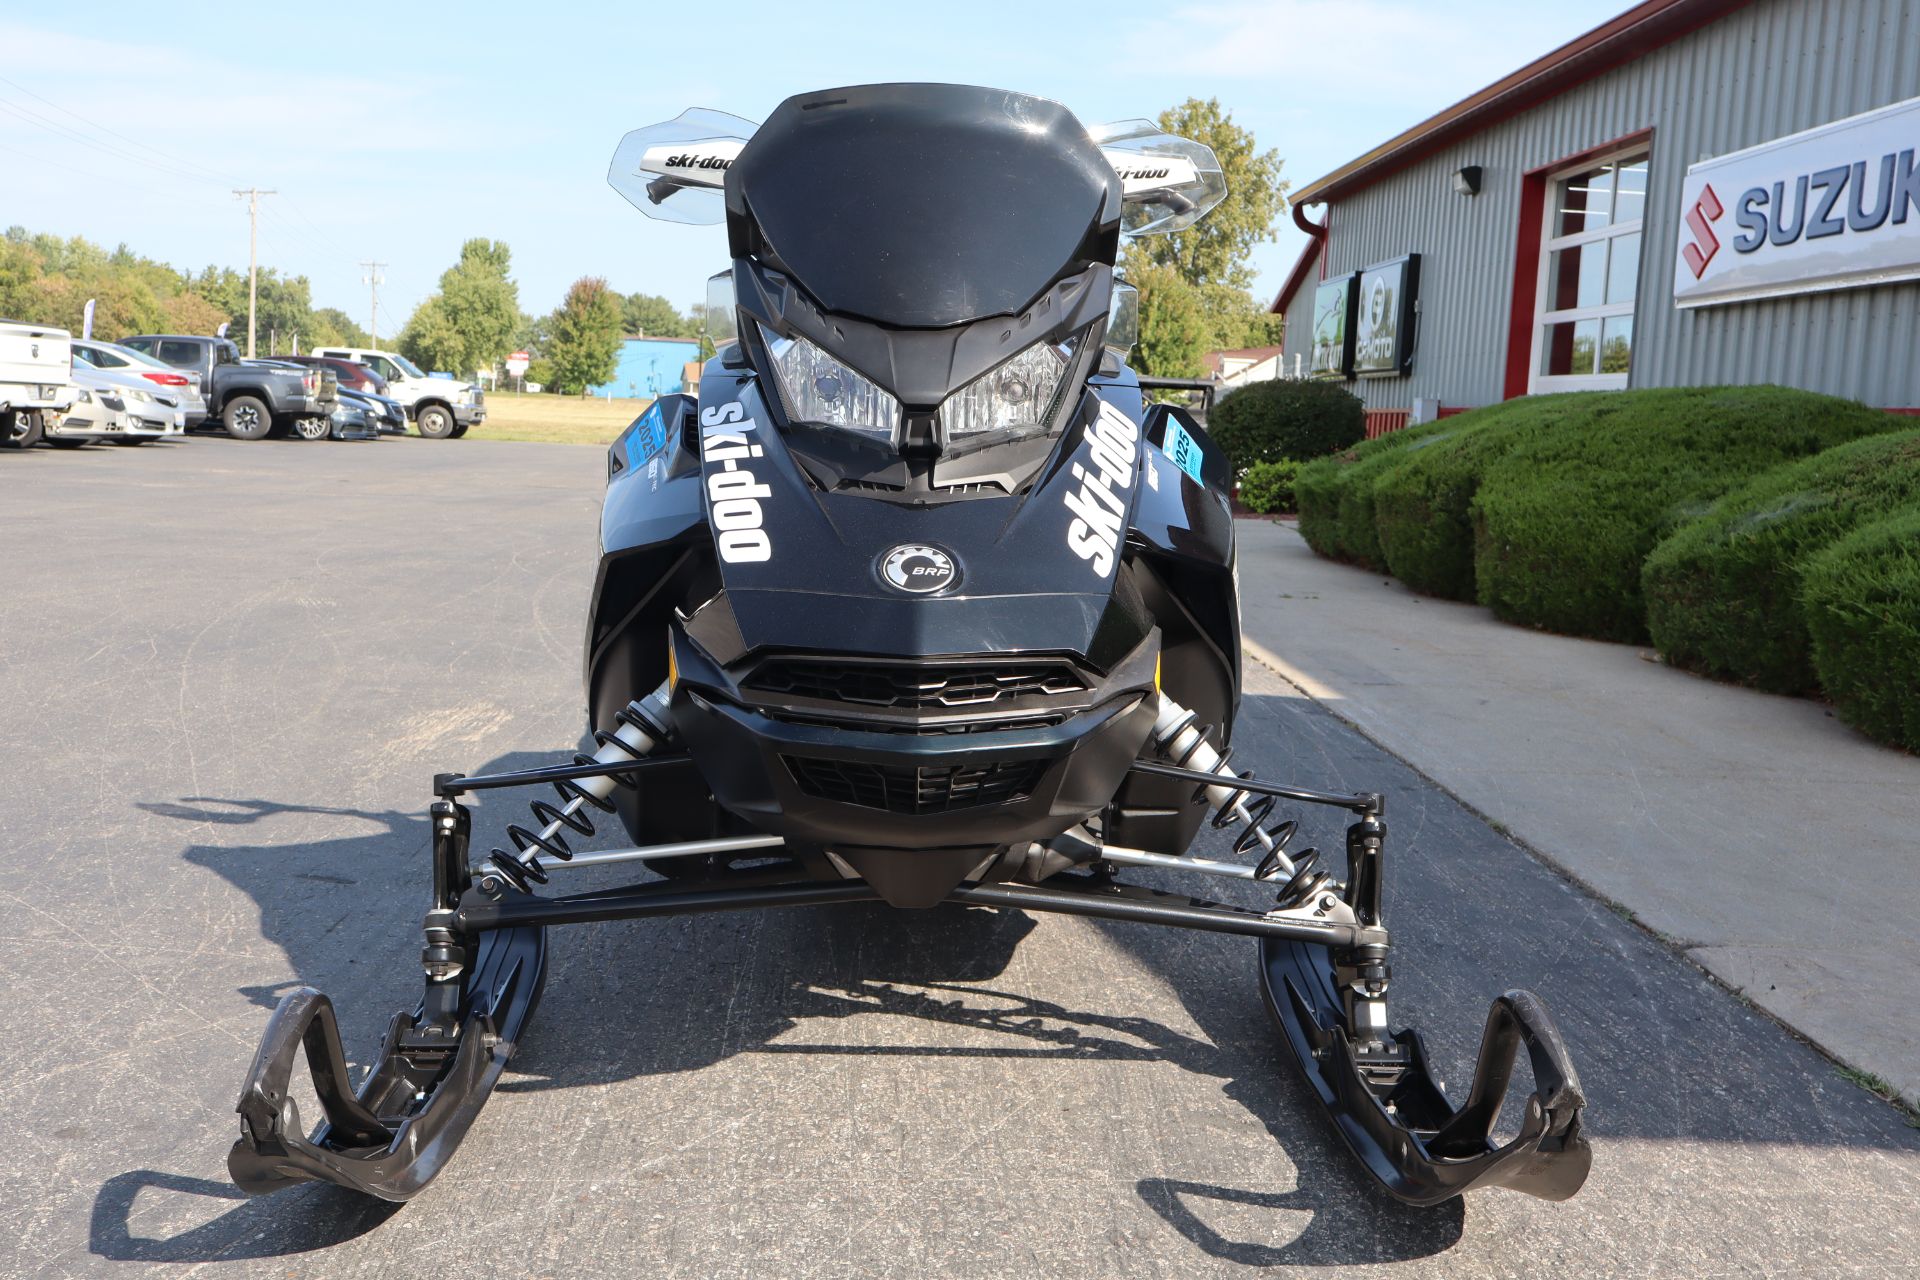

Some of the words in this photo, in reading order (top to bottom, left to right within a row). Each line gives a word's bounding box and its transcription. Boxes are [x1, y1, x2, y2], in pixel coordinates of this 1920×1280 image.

[639, 419, 656, 459] 2025
[701, 402, 772, 563] ski-doo
[1064, 400, 1138, 578] ski-doo
[912, 567, 949, 576] BRP
